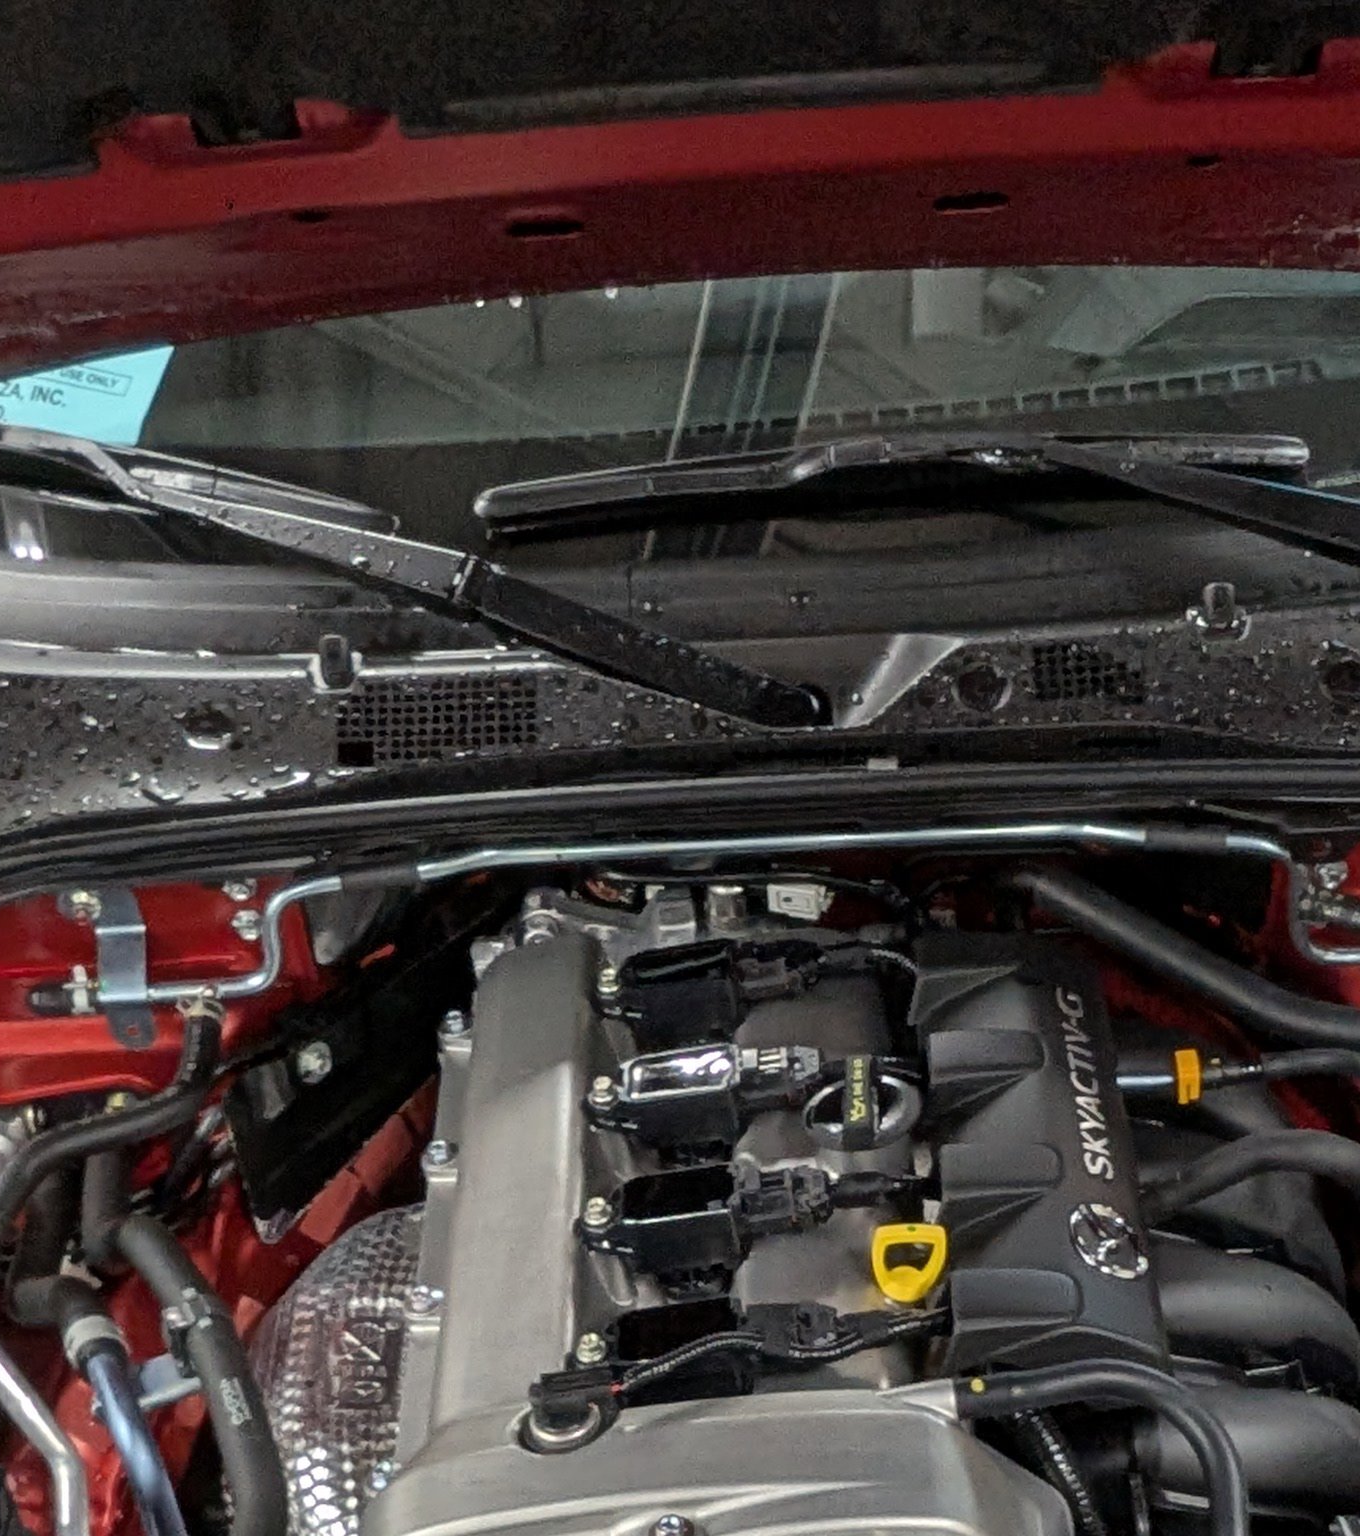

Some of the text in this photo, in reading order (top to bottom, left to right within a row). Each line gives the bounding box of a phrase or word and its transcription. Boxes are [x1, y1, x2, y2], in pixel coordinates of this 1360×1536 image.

[84, 370, 119, 388] ONLY
[29, 385, 67, 408] INC.
[1056, 987, 1114, 1180] SKYACTIV-G
